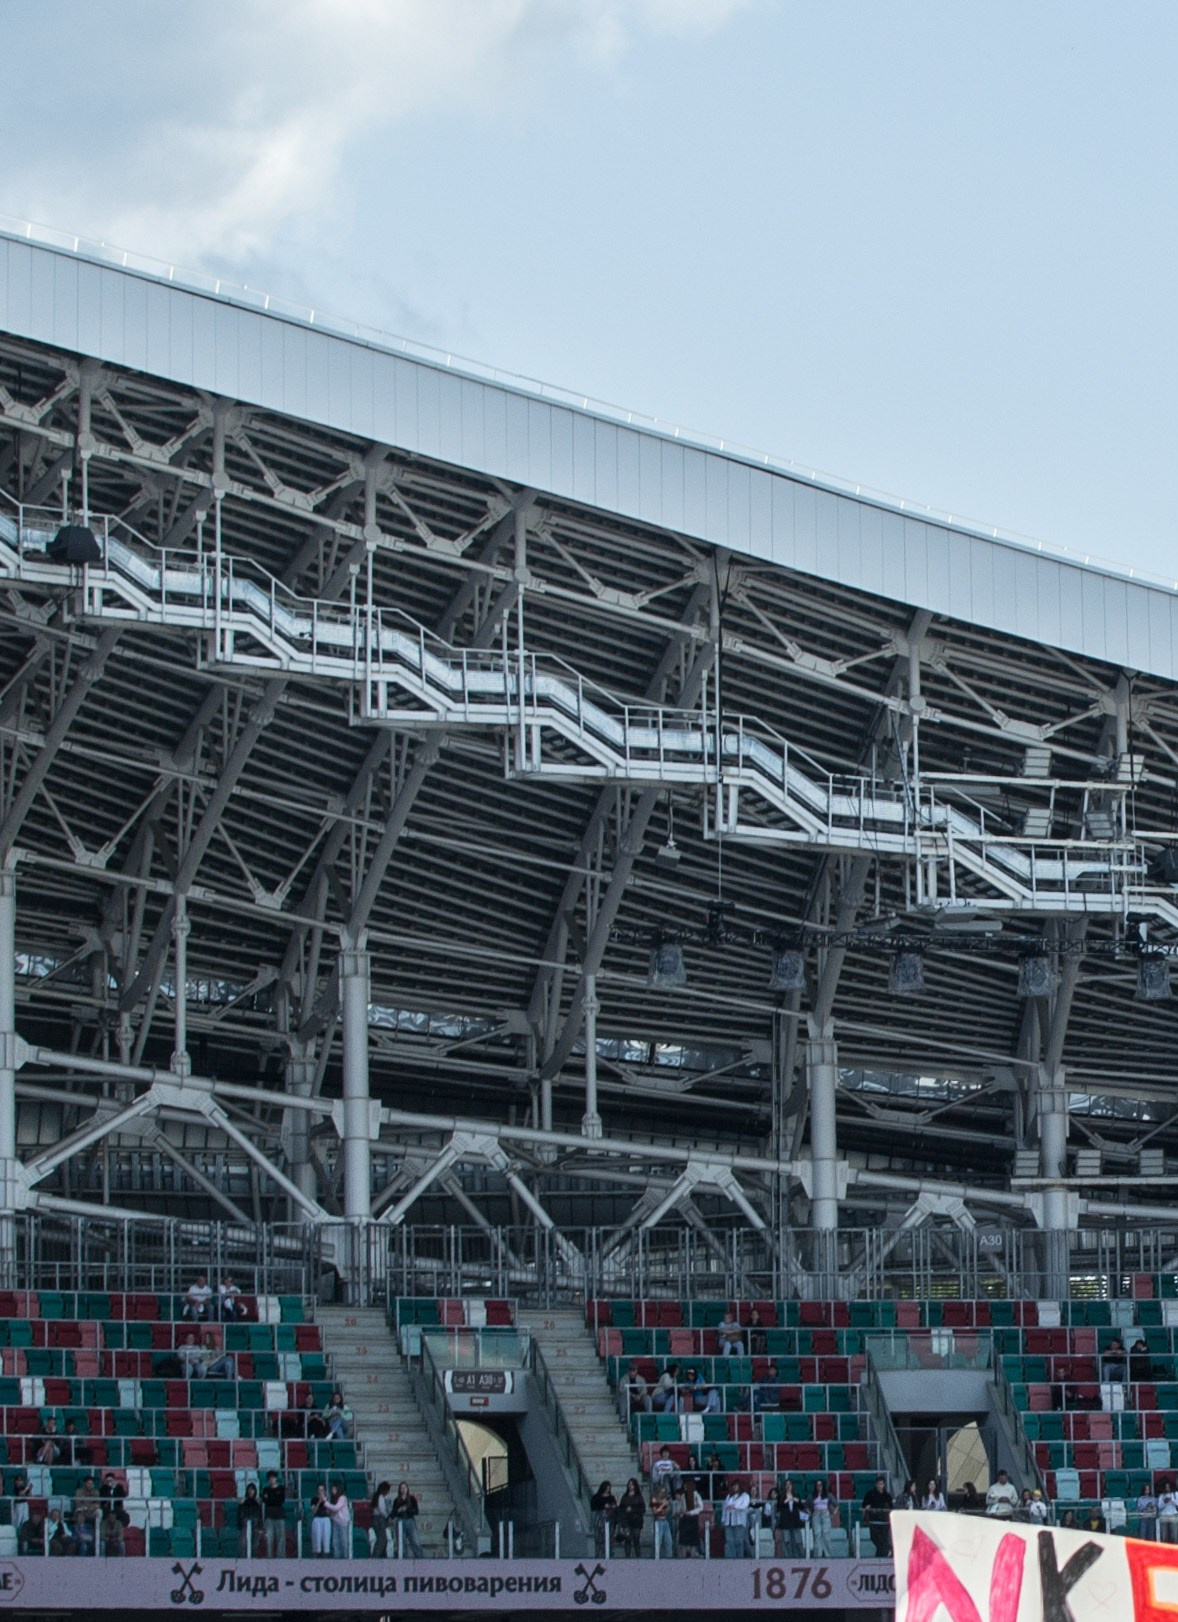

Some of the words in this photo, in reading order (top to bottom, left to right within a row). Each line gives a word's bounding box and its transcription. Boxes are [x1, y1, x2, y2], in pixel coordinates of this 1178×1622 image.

[979, 1235, 1003, 1246] A30
[216, 1570, 280, 1597] Лида
[300, 1576, 397, 1598] столица
[403, 1575, 562, 1598] пивоварения
[751, 1566, 833, 1600] 1876
